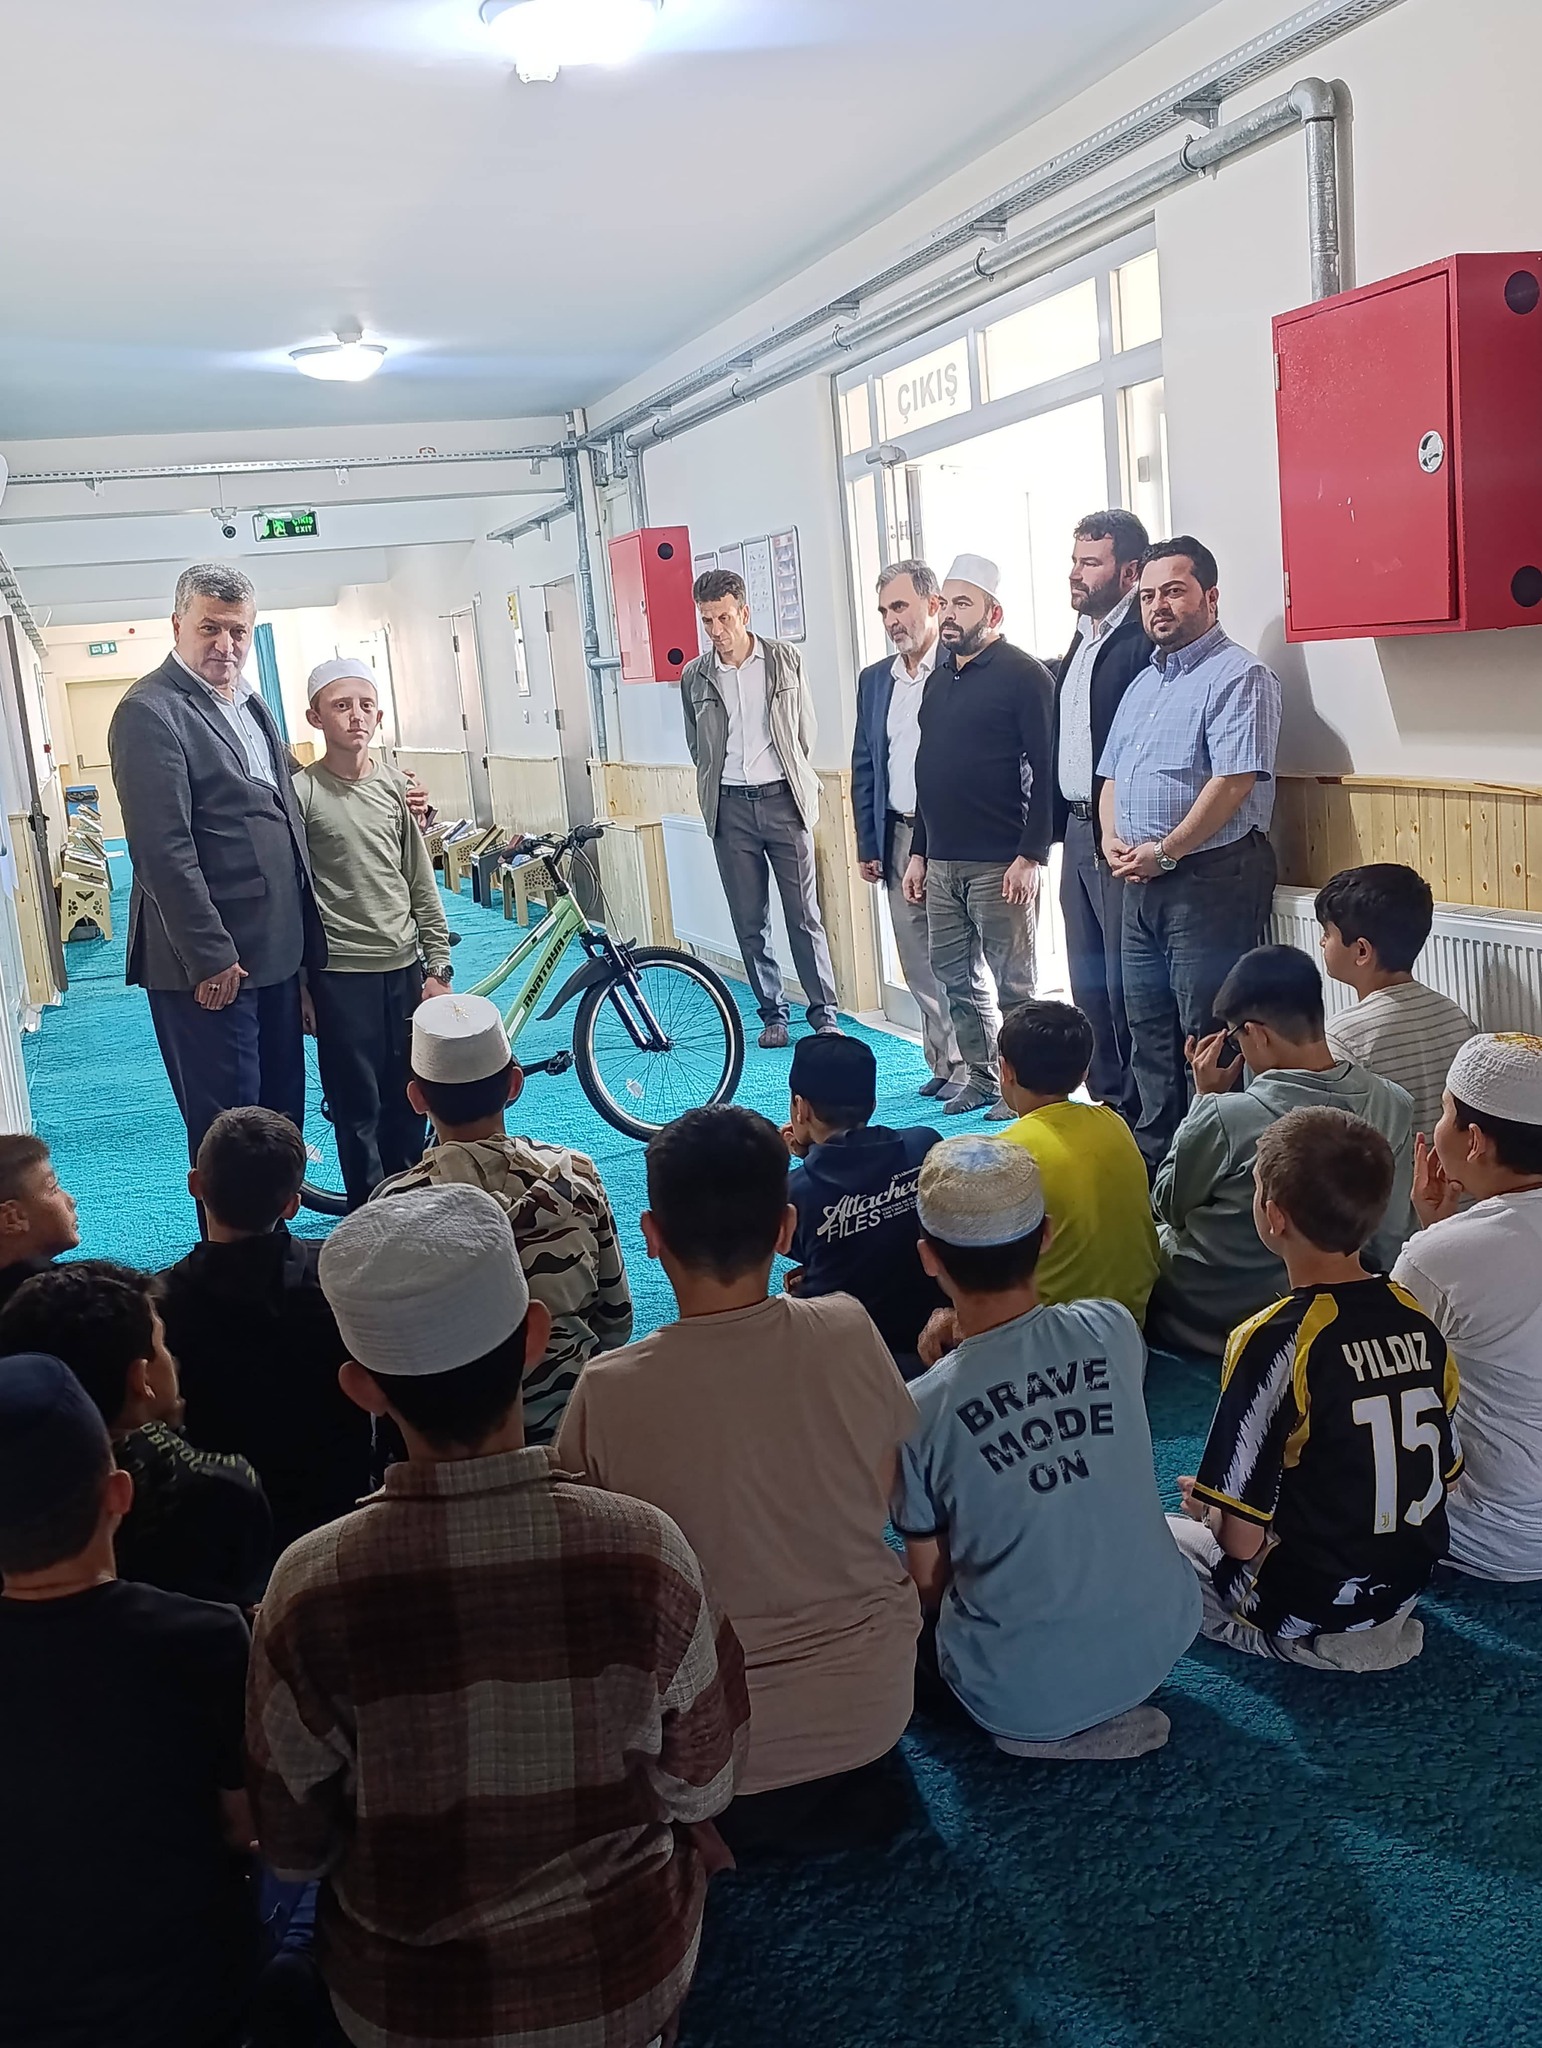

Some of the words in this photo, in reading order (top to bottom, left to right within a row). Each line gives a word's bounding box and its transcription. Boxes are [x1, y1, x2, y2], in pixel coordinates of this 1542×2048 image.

[898, 362, 958, 425] ÇIKIŞ
[294, 525, 312, 534] EXIT
[827, 1208, 881, 1243] FILES
[1341, 1331, 1432, 1382] YILDIZ
[955, 1357, 1110, 1437] BRAVE
[979, 1402, 1114, 1476] MODE
[1352, 1386, 1443, 1535] 15
[1028, 1449, 1090, 1494] ON
